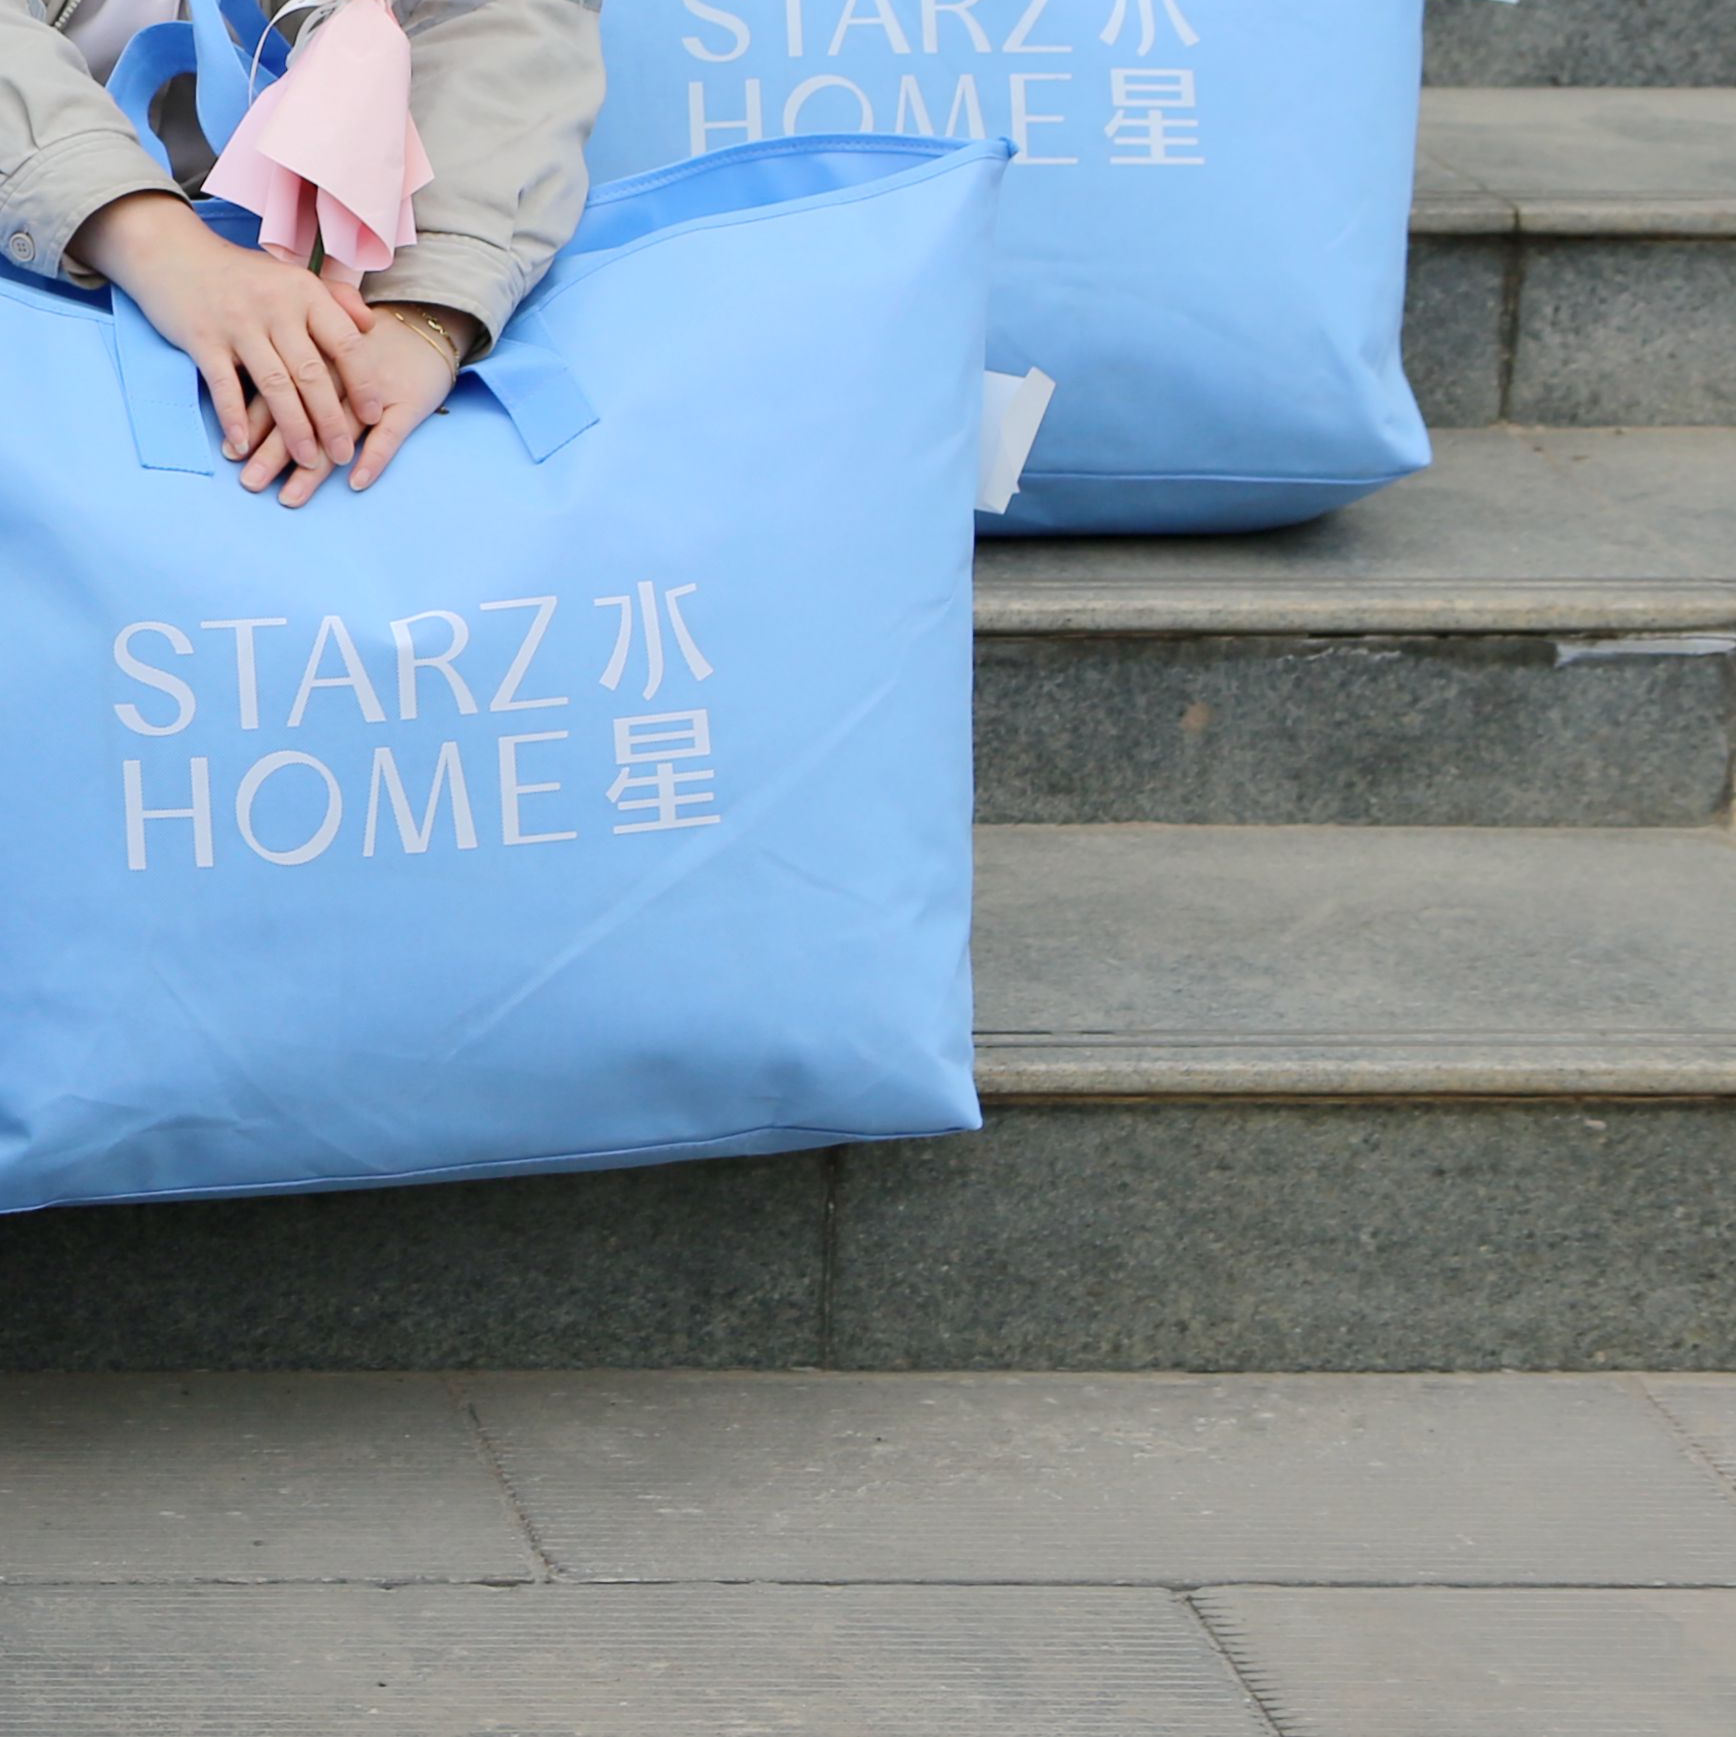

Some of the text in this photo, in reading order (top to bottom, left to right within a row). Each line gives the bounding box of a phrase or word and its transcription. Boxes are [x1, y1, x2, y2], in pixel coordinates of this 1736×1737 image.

[1104, 67, 1206, 165] 星
[113, 580, 714, 737] STARZ 水
[123, 709, 721, 871] HOME 星
